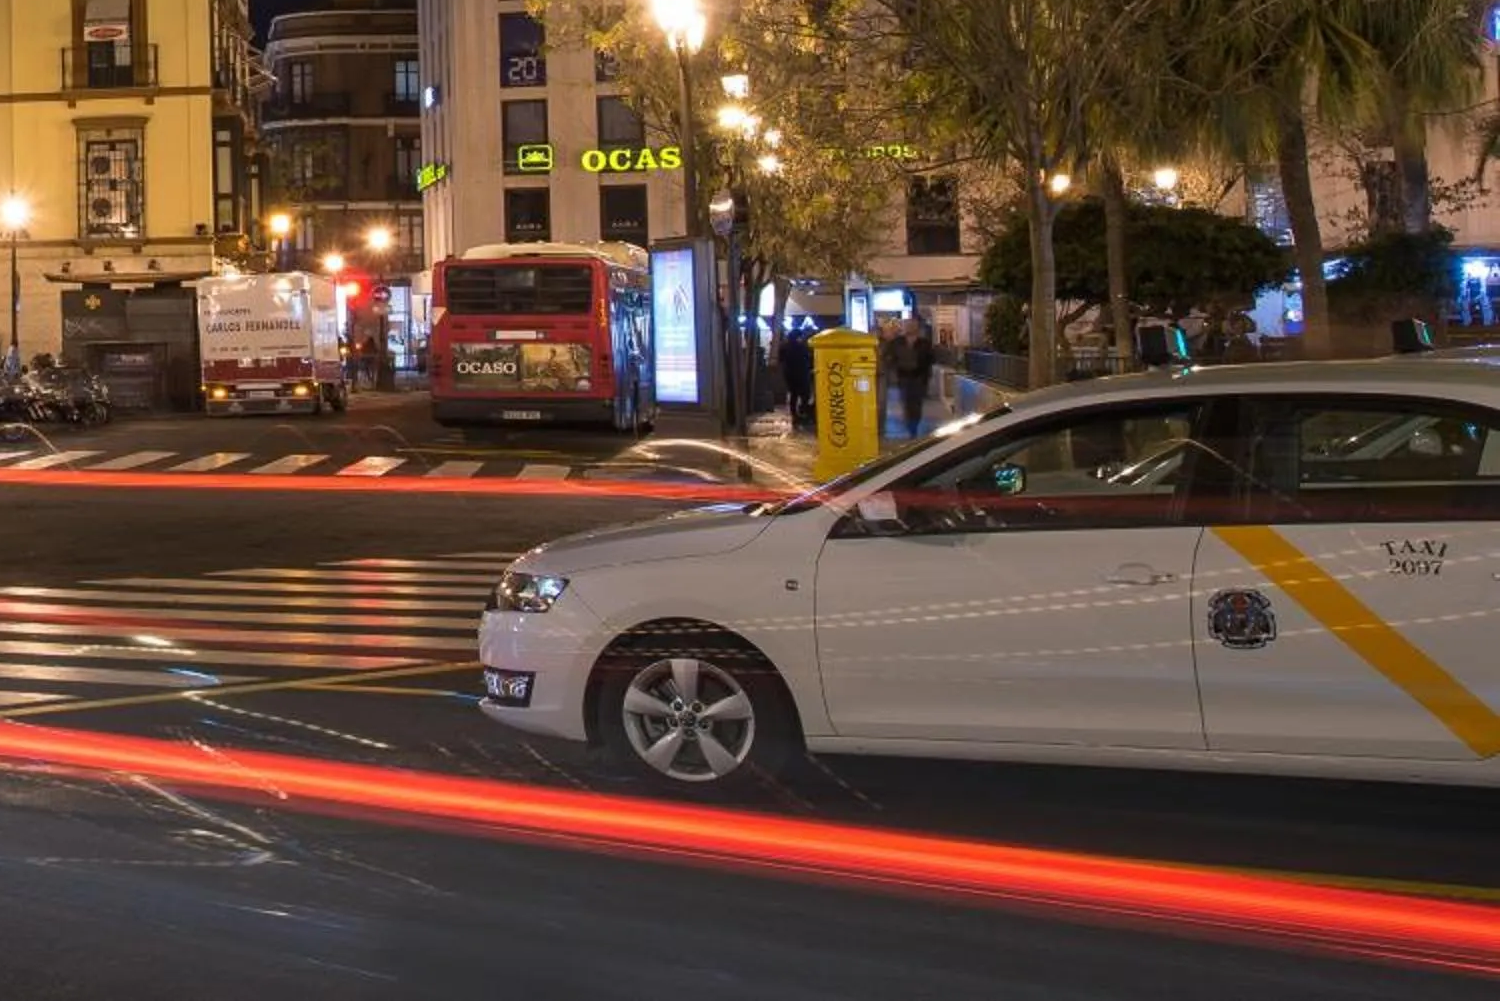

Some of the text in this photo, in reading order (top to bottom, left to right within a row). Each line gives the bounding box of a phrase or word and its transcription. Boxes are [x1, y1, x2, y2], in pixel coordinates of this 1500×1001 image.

[508, 57, 537, 81] 20
[581, 148, 682, 172] OCAS
[205, 321, 241, 335] CARLOS
[457, 362, 517, 374] OCASO
[829, 361, 849, 448] CORREOS
[1380, 540, 1447, 557] TAXI
